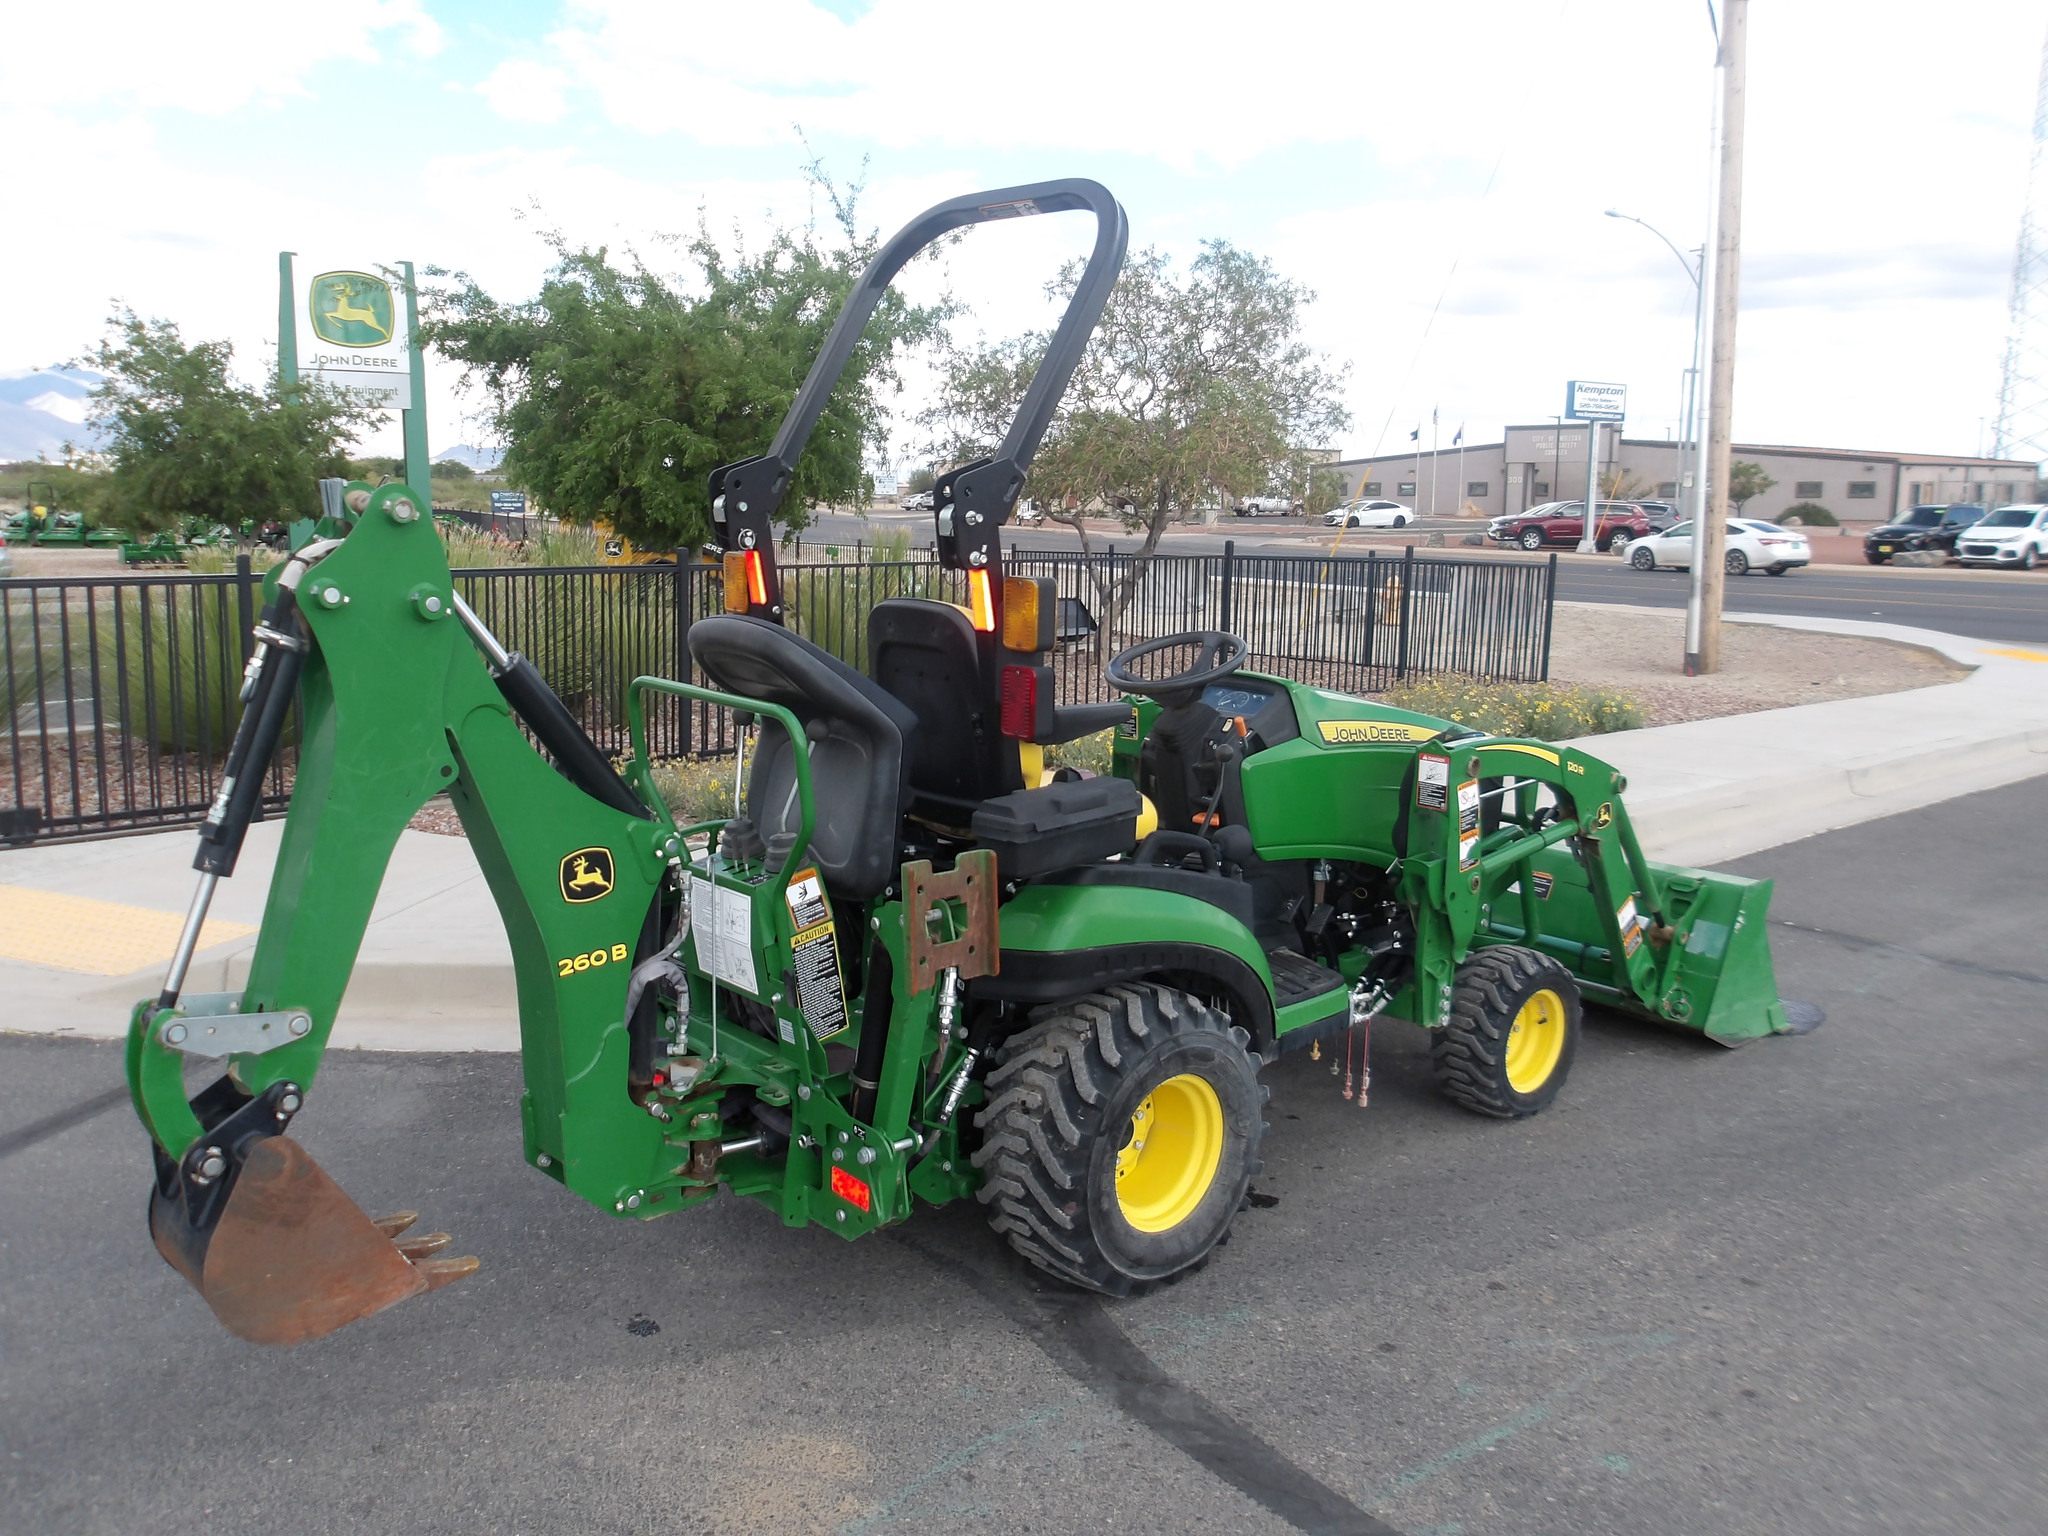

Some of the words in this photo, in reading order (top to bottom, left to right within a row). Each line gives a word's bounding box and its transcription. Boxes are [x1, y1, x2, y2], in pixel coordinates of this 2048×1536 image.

[310, 353, 350, 365] JOHN
[352, 355, 398, 368] DEERE
[344, 384, 399, 396] Equipment
[1576, 384, 1624, 396] Kempton
[1507, 476, 1523, 484] 300
[1333, 726, 1368, 741] JOHN
[1369, 726, 1411, 740] DEERE
[800, 924, 829, 942] CAUTION
[558, 949, 608, 977] 260
[611, 943, 628, 963] B
